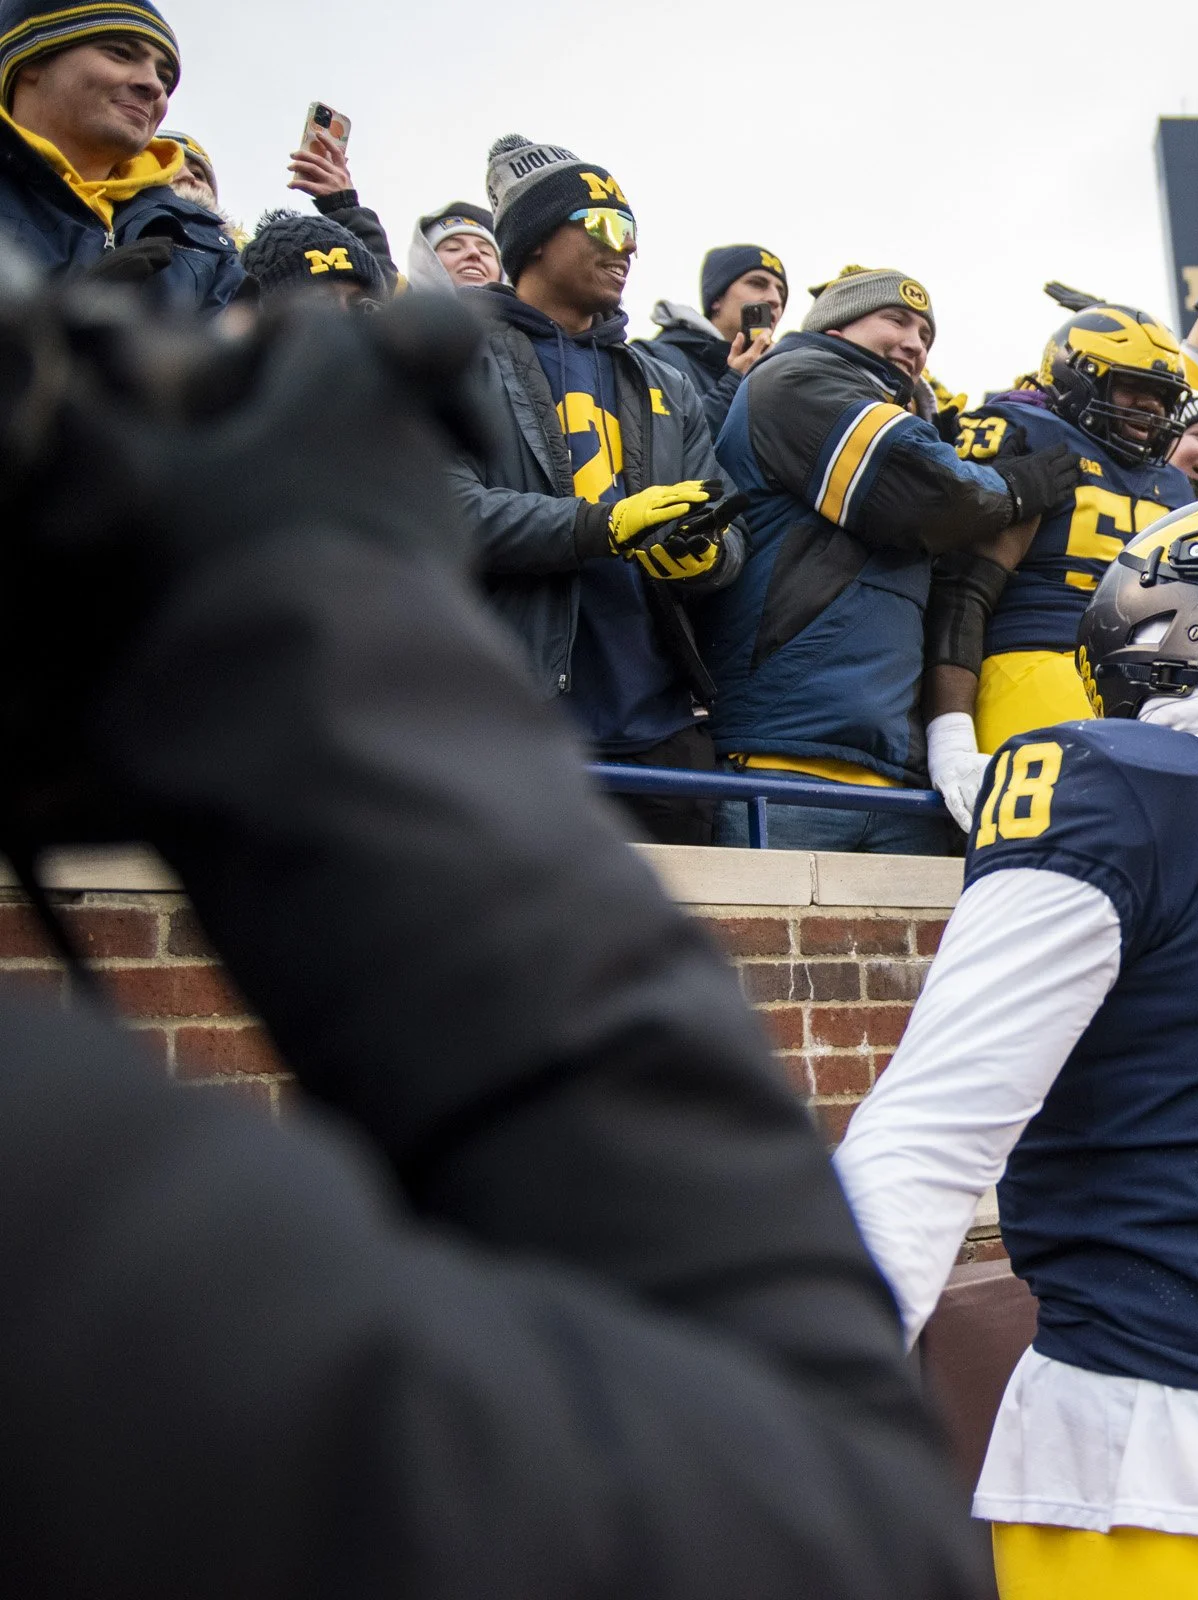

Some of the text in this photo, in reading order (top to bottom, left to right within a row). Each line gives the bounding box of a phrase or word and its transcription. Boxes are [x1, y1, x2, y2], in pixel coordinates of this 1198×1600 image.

[579, 172, 628, 205] M
[304, 247, 353, 274] M
[976, 741, 1064, 851] 18
